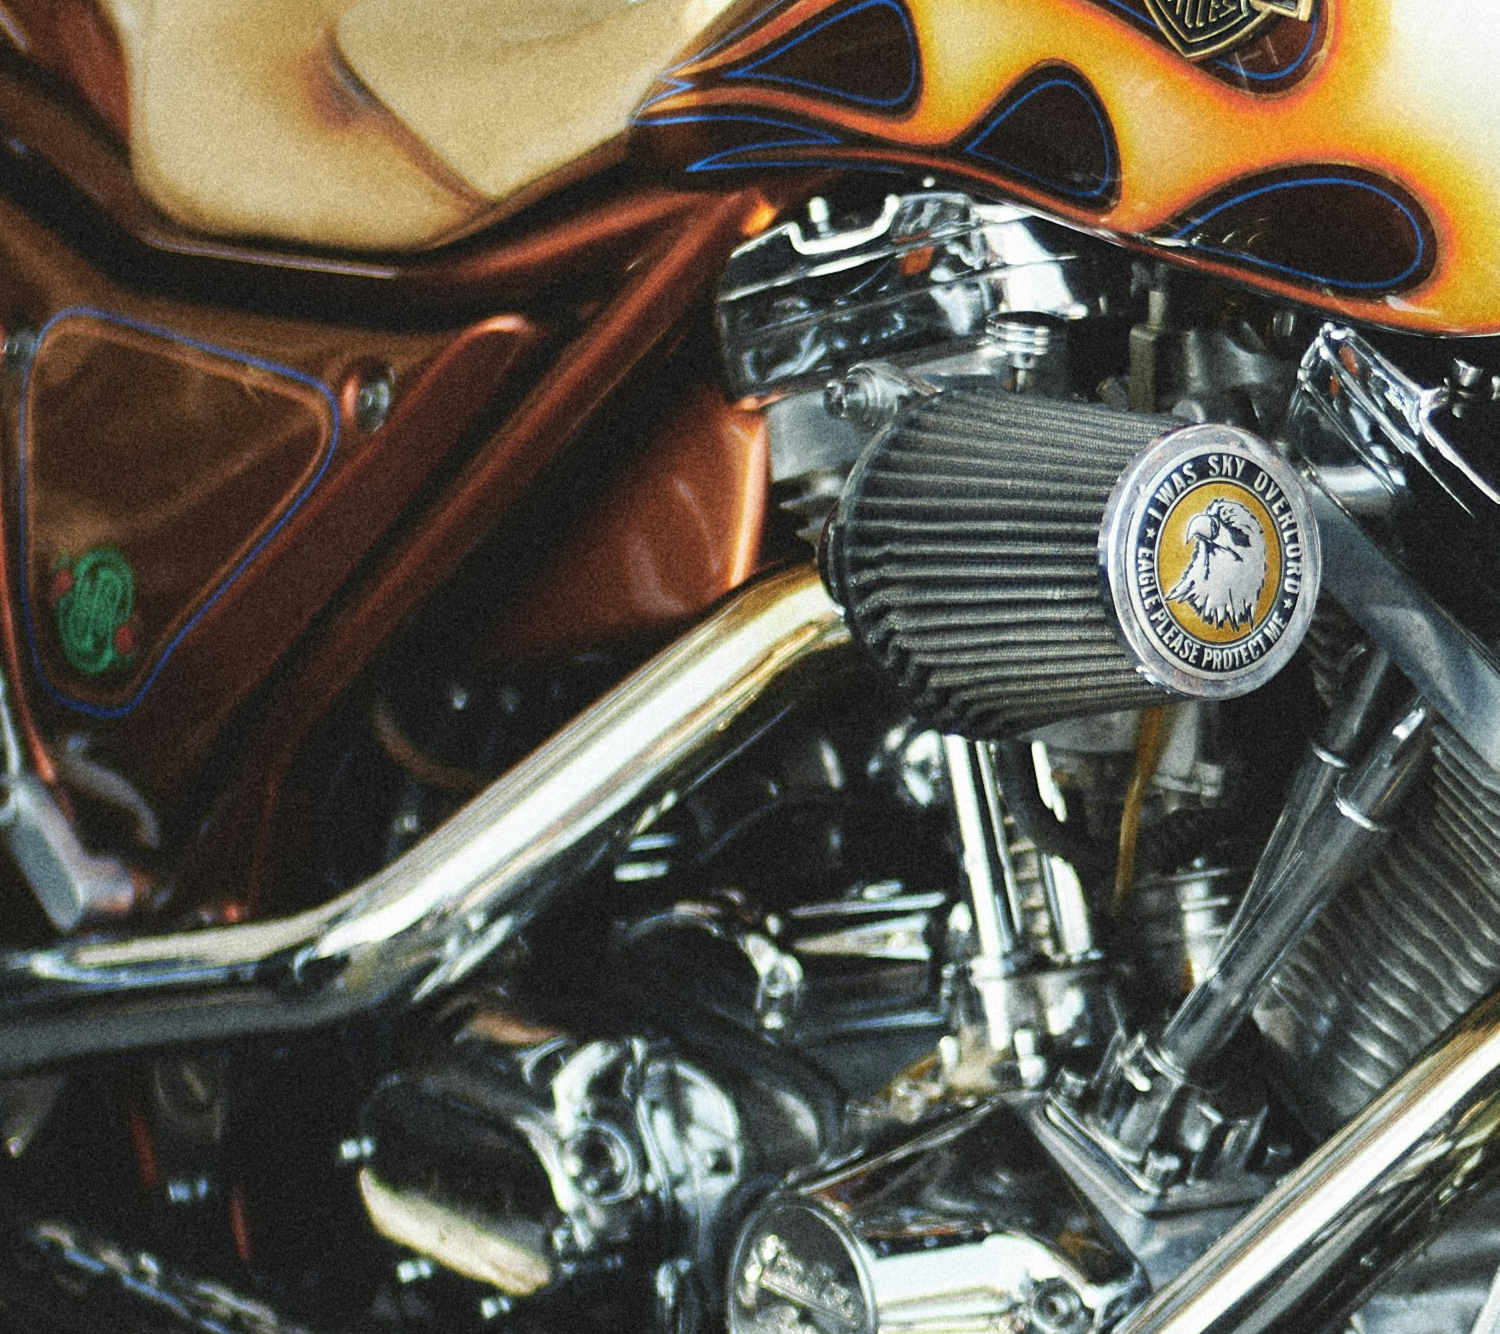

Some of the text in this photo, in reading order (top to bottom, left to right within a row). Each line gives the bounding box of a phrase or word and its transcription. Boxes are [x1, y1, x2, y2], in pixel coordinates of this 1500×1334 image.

[1148, 455, 1302, 594] I WAS SKY OVERLORD
[1137, 547, 1288, 670] EAGLE PLEASE PROTECT ME
